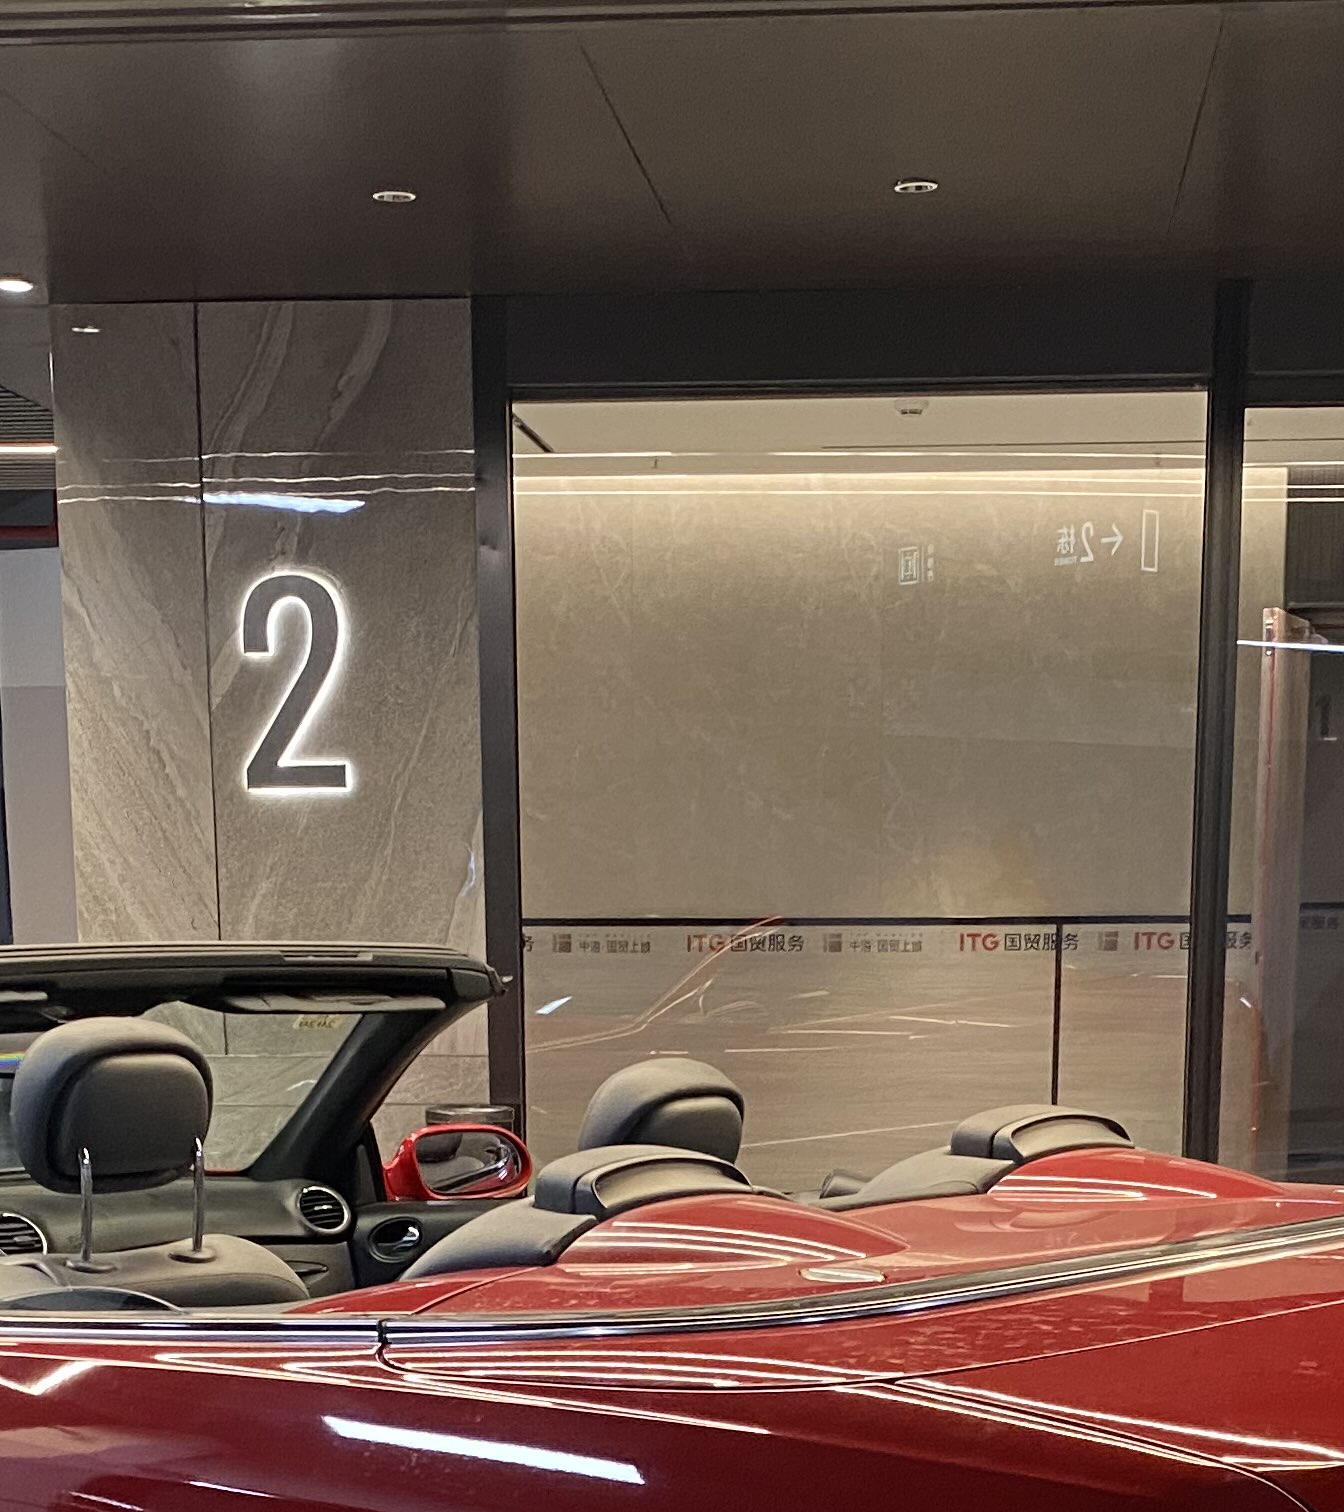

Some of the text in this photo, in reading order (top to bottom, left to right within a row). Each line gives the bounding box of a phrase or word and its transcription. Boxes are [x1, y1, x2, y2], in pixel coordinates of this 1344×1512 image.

[242, 572, 350, 791] 2
[687, 934, 725, 952] ITG
[959, 933, 999, 951] ITG
[1134, 932, 1174, 950] ITG
